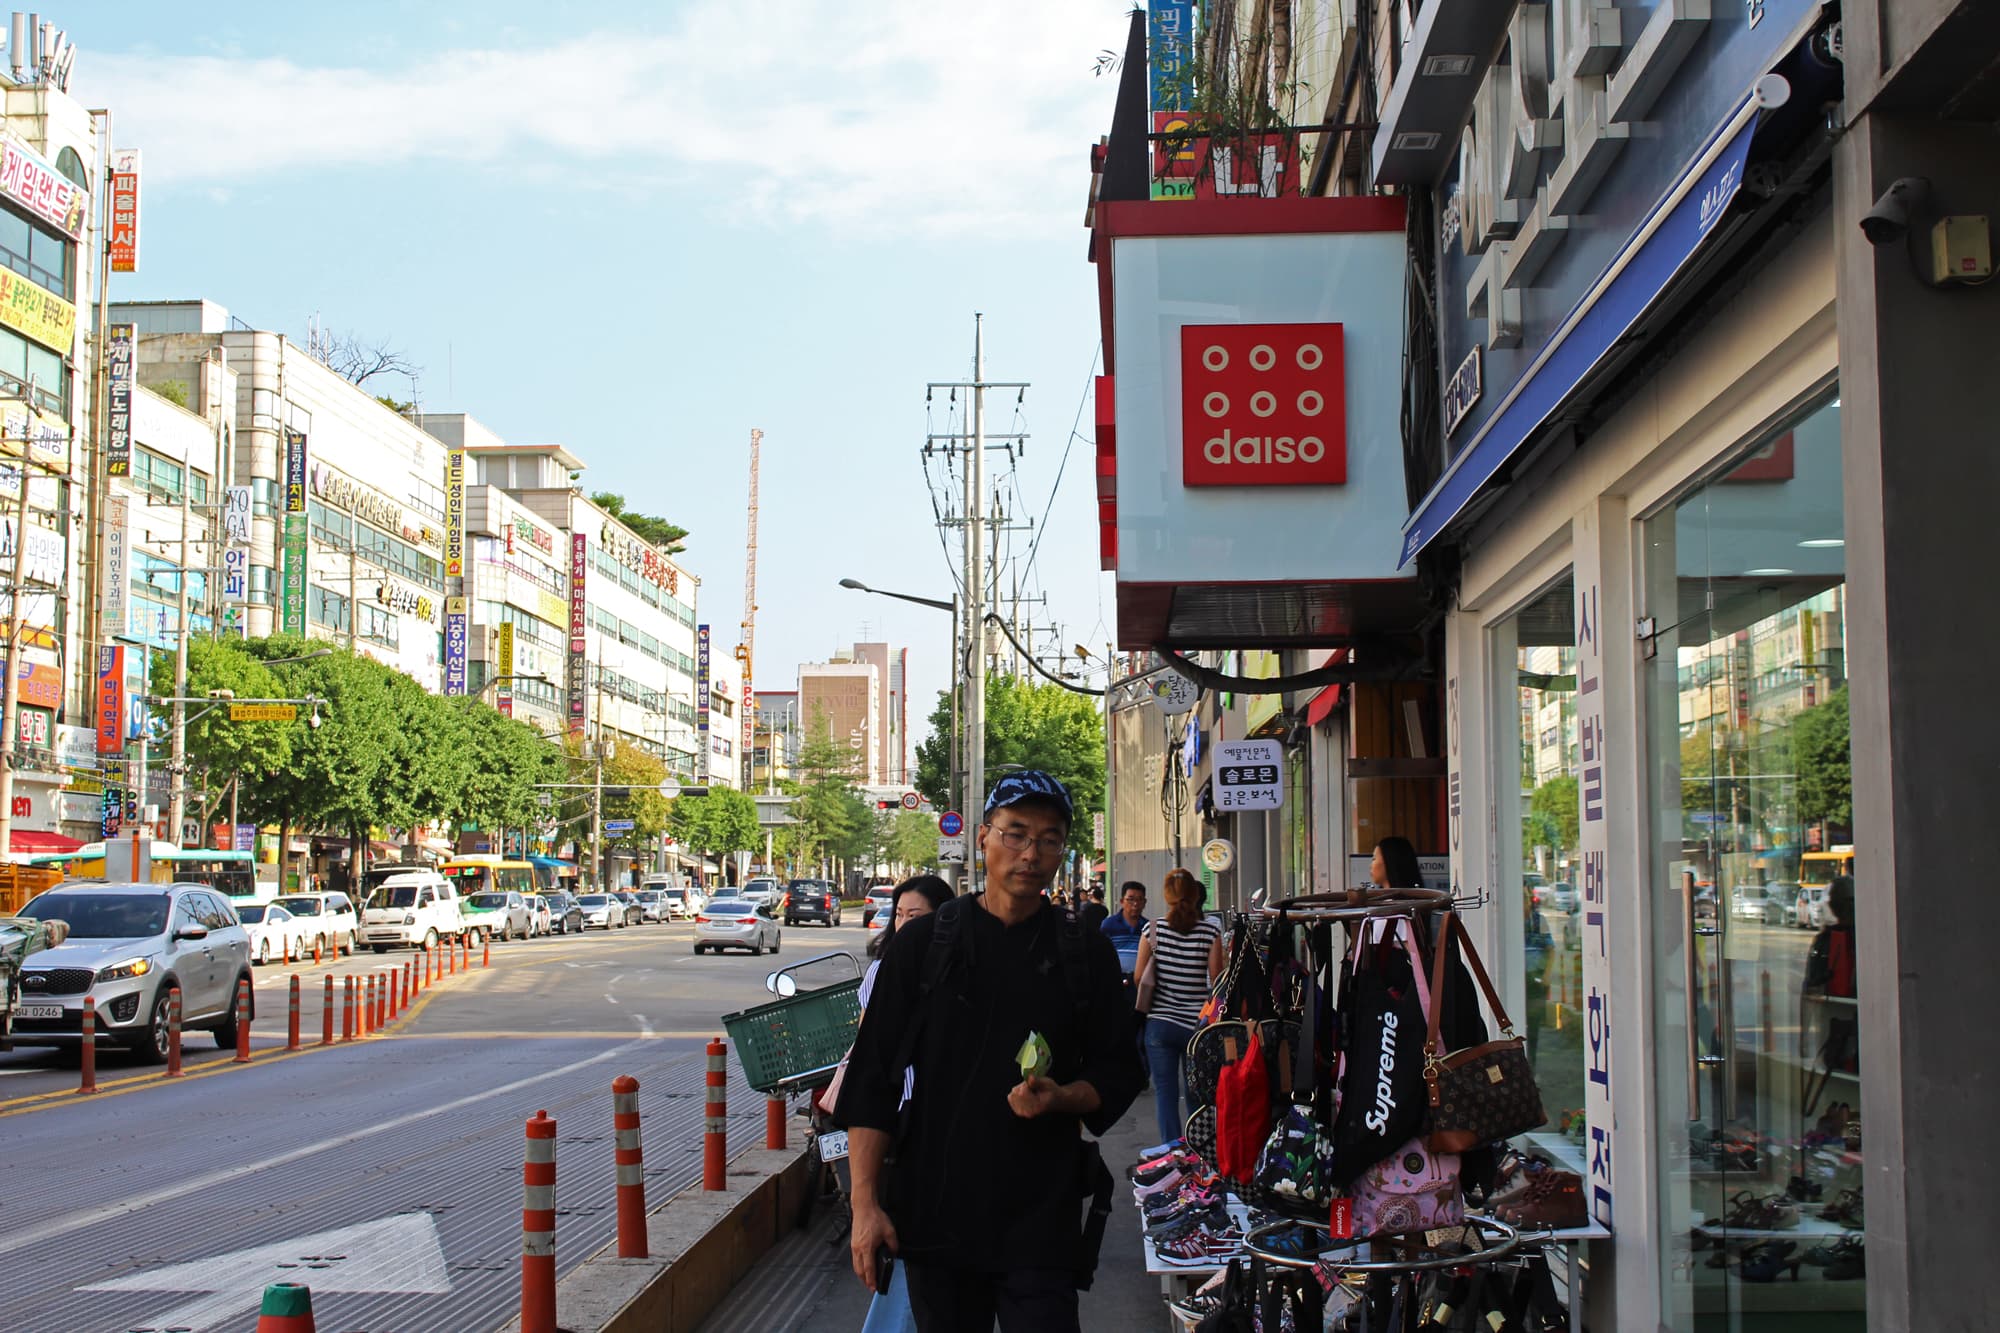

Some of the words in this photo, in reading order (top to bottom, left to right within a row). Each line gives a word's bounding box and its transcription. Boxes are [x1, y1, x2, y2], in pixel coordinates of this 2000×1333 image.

[4, 151, 69, 221] 게임랜드
[1203, 428, 1326, 465] daiso
[109, 462, 127, 474] 4F
[290, 444, 303, 483] 프라우드
[228, 489, 249, 513] YO
[289, 484, 303, 512] 치과
[449, 454, 462, 559] 월드성인게임장
[226, 513, 248, 538] GA
[225, 551, 245, 597] 안과
[573, 588, 584, 623] 마사지
[743, 686, 753, 707] PC
[1223, 746, 1272, 761] 예물전문점
[1225, 767, 1274, 783] 솔로몬
[905, 795, 915, 805] 60
[1579, 584, 1612, 1233] 신발백화점
[32, 1007, 58, 1017] 0246
[1365, 1011, 1399, 1137] Supreme
